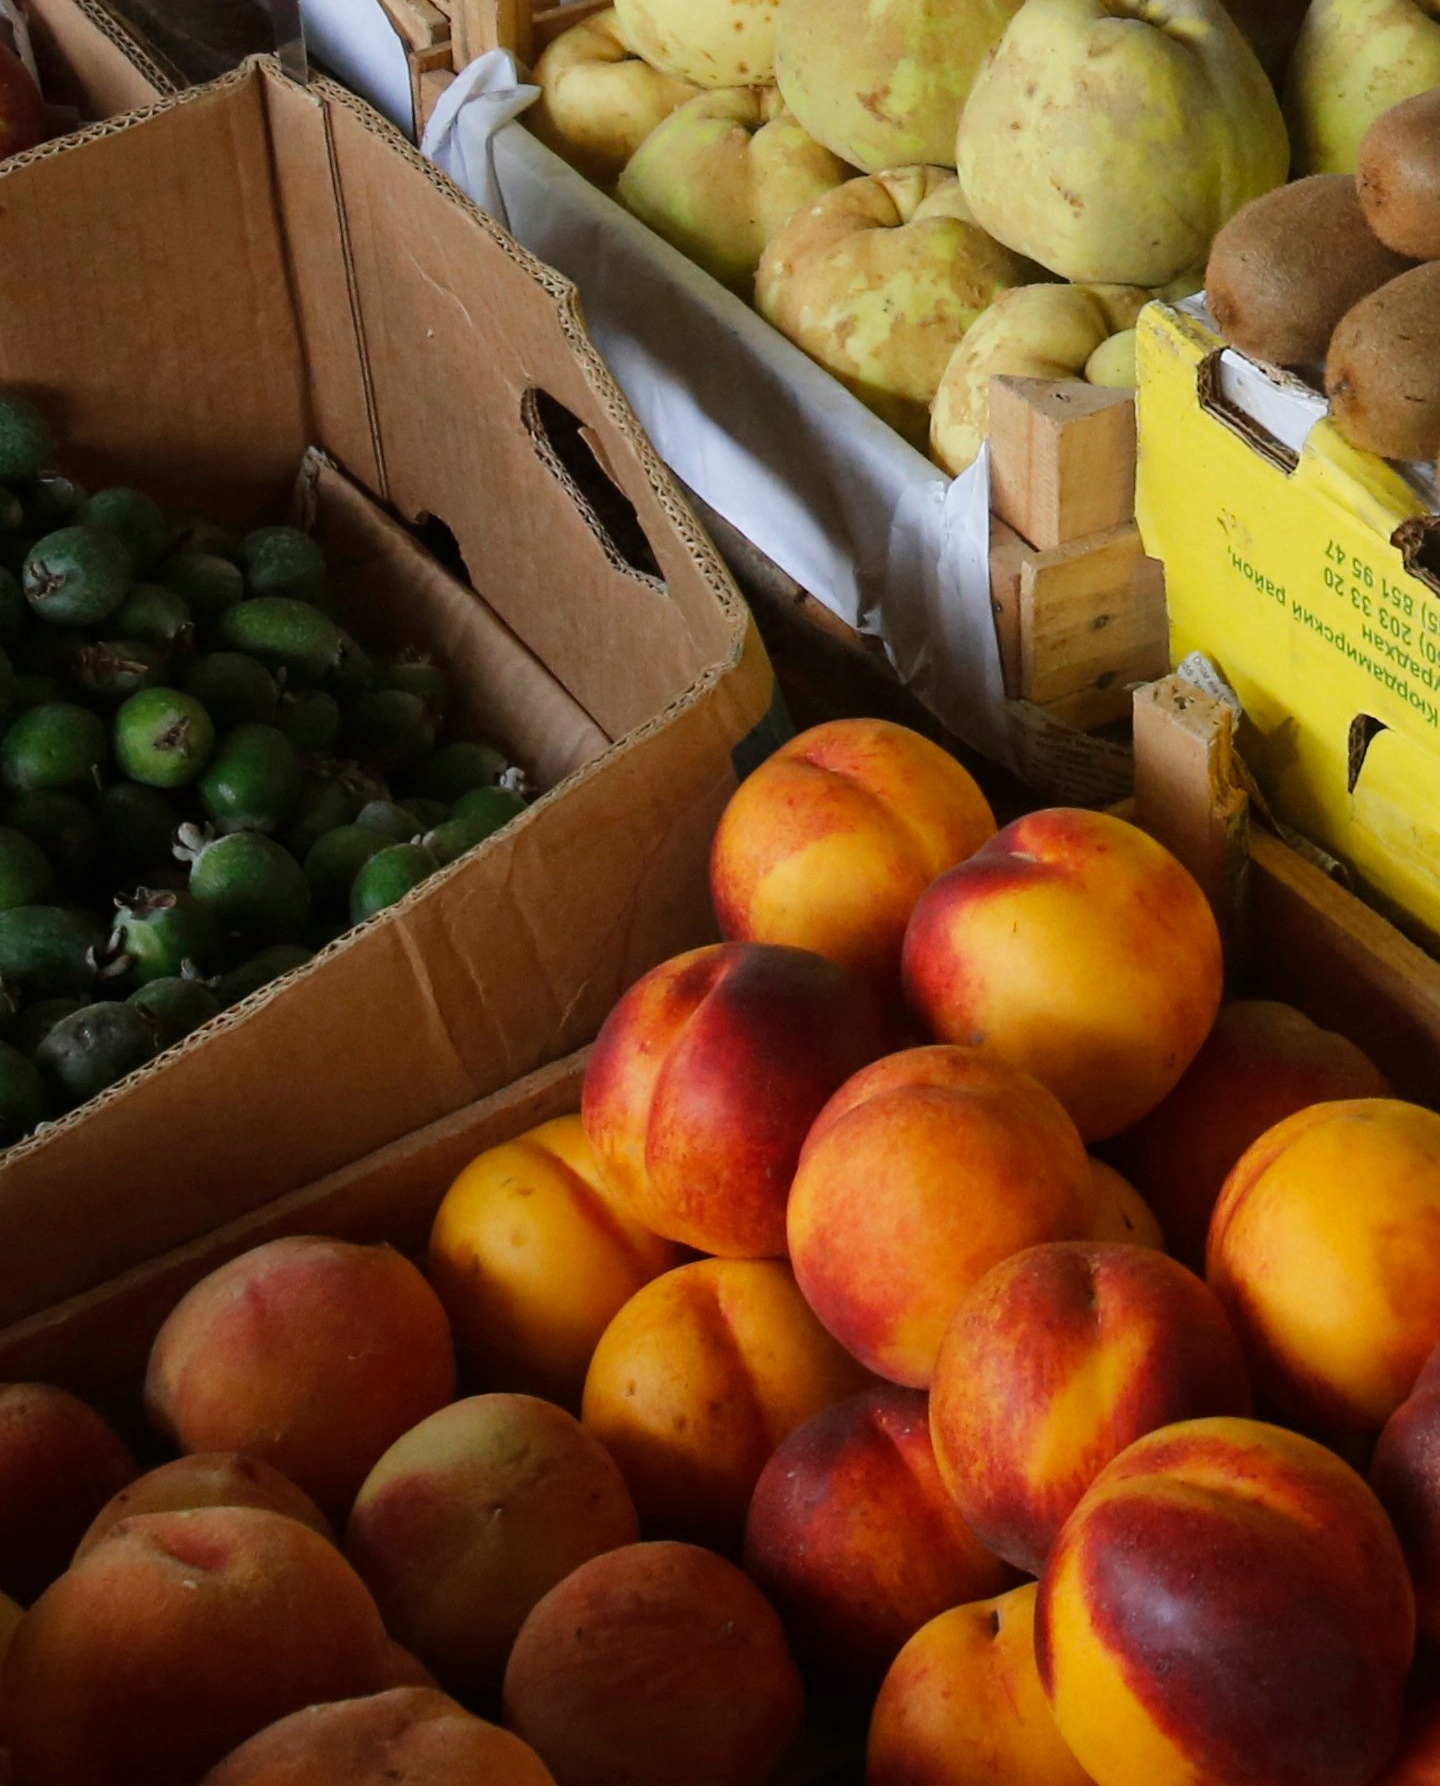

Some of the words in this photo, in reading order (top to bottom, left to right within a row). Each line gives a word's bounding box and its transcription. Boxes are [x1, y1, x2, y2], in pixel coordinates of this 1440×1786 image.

[1327, 539, 1344, 563] 47
[1223, 546, 1287, 605] район,
[1324, 567, 1343, 593] 20
[1353, 558, 1370, 583] 95
[1350, 586, 1369, 613] 33
[1382, 580, 1409, 612] 851
[1378, 607, 1409, 642] 203
